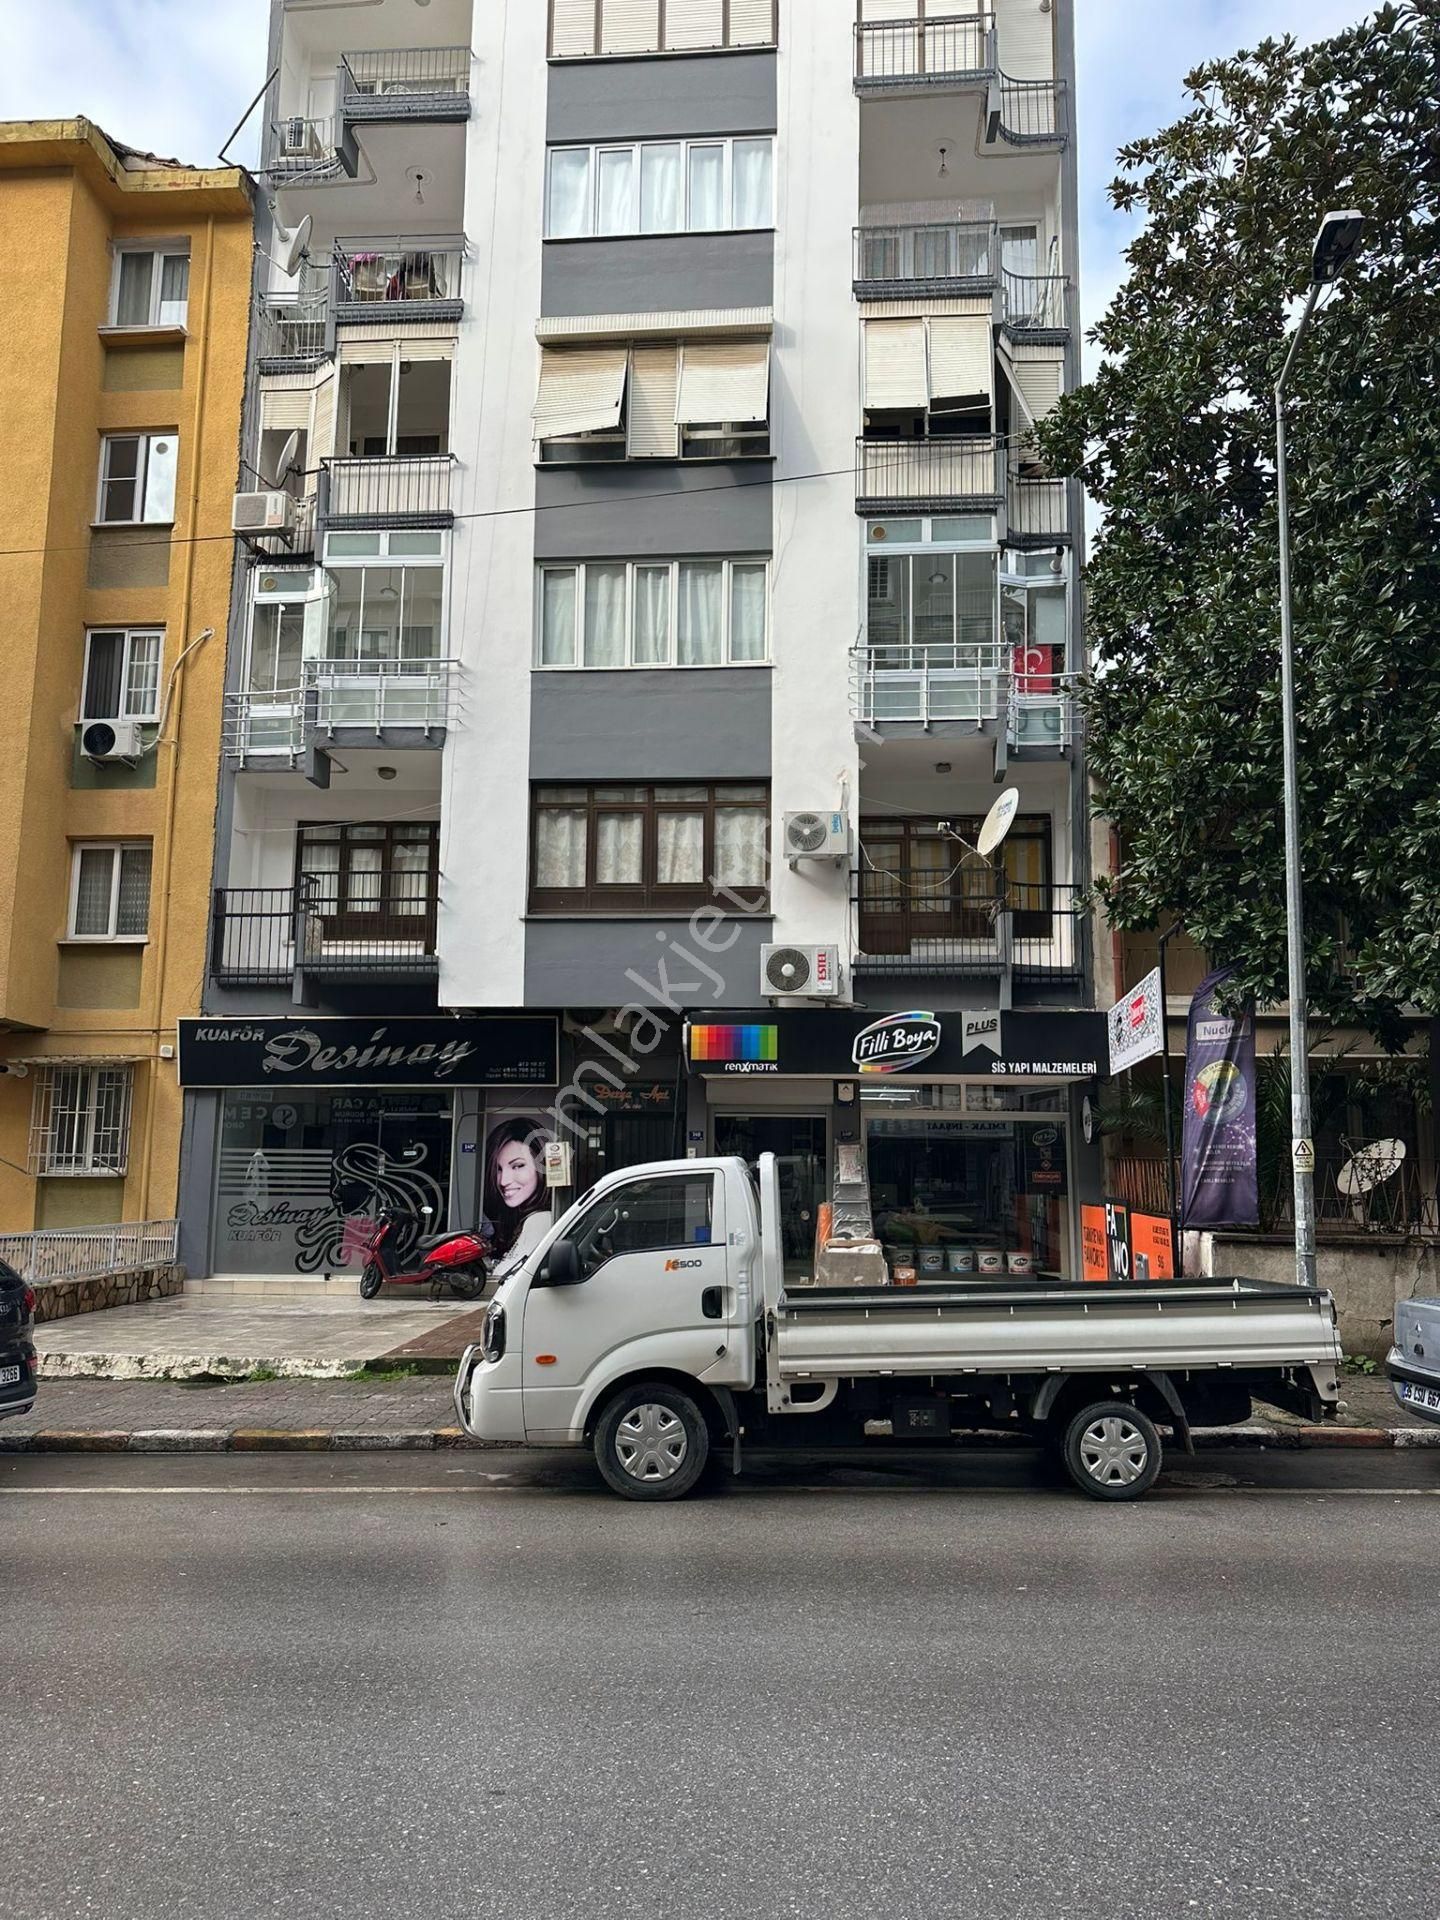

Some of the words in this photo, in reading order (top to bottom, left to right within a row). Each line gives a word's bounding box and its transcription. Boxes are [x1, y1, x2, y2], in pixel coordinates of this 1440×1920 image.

[818, 951, 827, 983] ESTEL
[966, 1018, 998, 1033] PLUS
[195, 1026, 266, 1042] KUAFÖR
[860, 1035, 889, 1057] Filli
[893, 1029, 936, 1051] Boya
[262, 1026, 478, 1077] Desinay
[991, 1060, 1007, 1074] SİS
[1008, 1062, 1030, 1074] YAPI
[1032, 1060, 1097, 1074] MALZEMELERİ
[227, 1229, 281, 1242] KUAFÖR
[665, 1259, 702, 1271] K2500
[1111, 1239, 1129, 1277] WO
